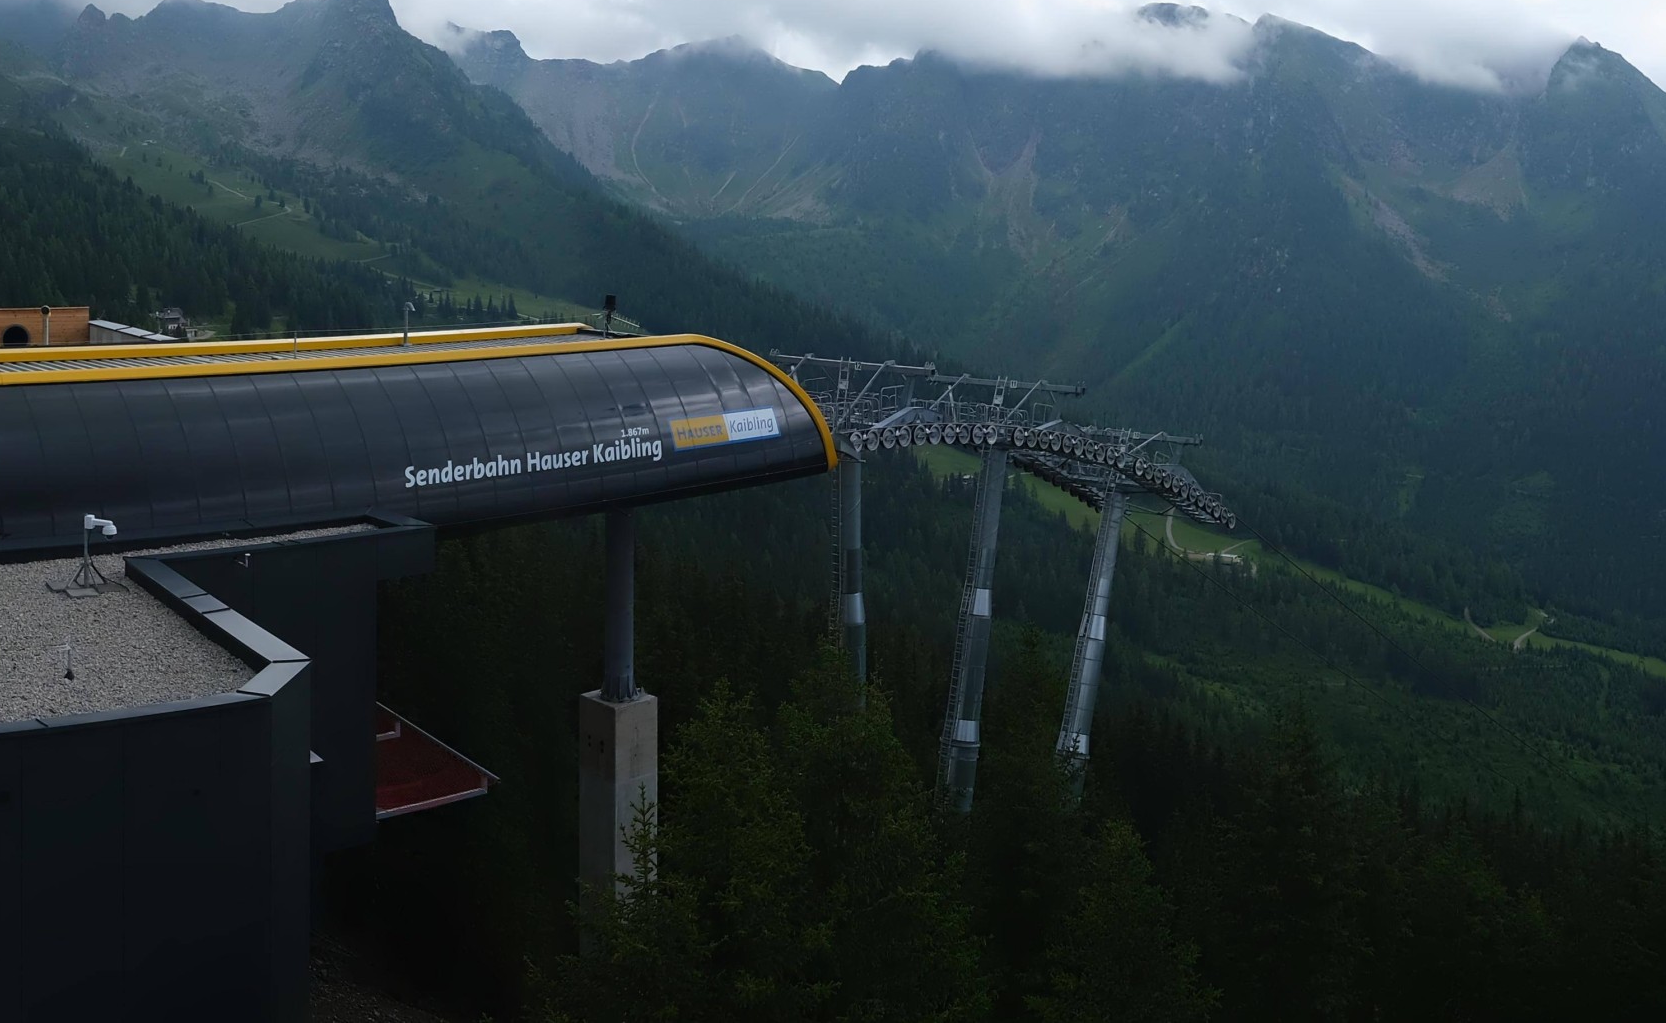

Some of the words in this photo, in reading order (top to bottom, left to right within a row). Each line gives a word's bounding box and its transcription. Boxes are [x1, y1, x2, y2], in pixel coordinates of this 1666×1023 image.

[620, 427, 650, 438] 1.867m
[676, 424, 723, 441] HAUSER
[729, 416, 774, 434] Kaibling
[404, 454, 522, 488] Senderbahn
[526, 449, 588, 472] Hauser
[592, 436, 662, 463] Kaibling
